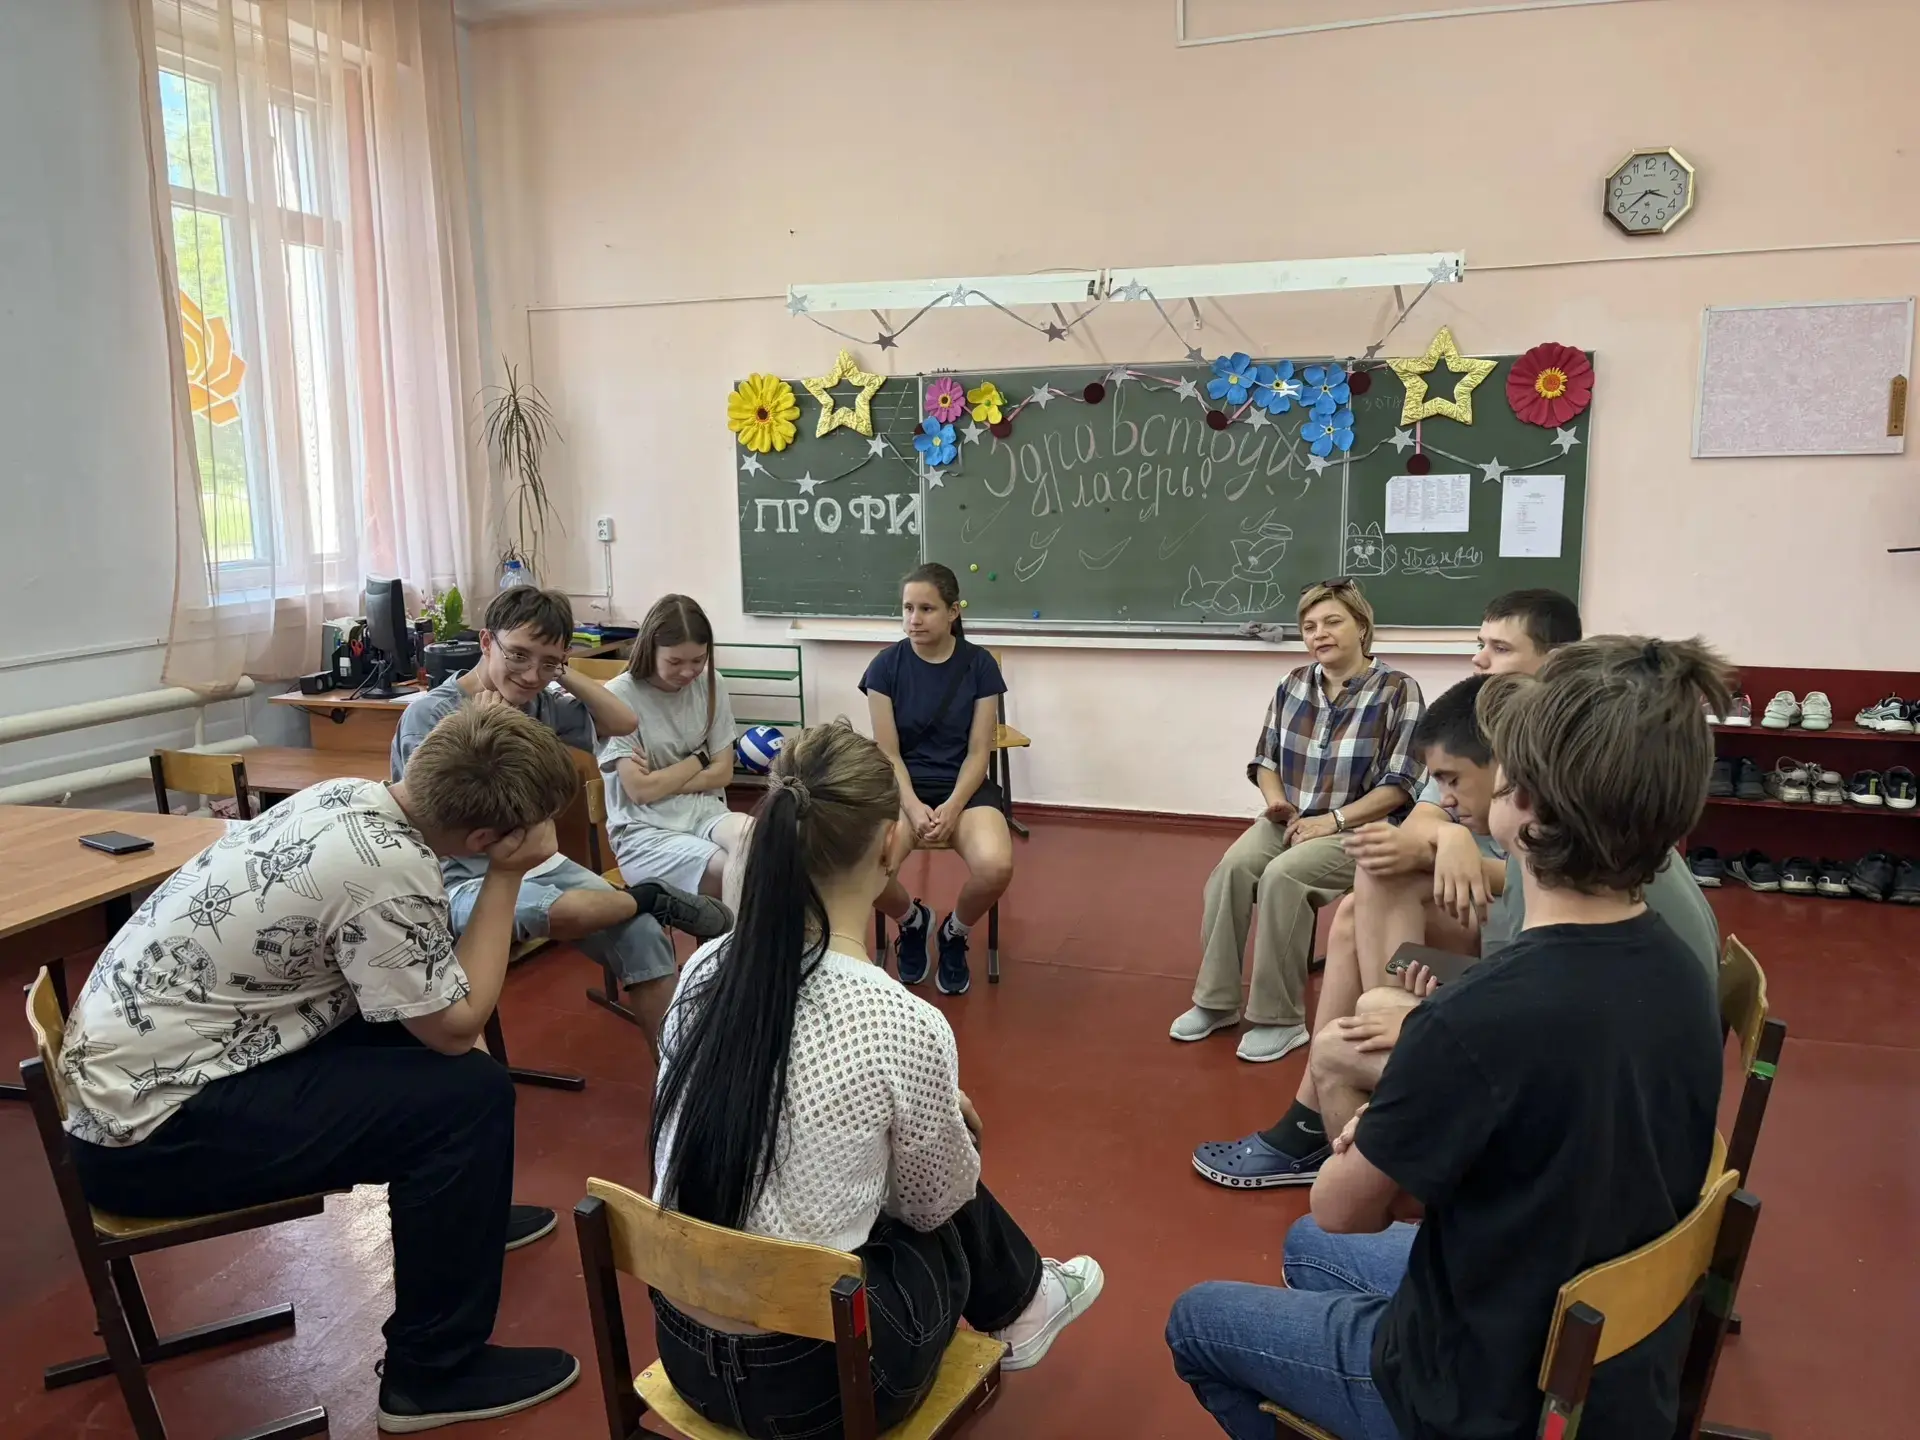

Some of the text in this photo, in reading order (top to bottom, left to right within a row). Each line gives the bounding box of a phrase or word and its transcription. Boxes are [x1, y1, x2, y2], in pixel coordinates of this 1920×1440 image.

[1632, 164, 1639, 174] 11
[1645, 157, 1657, 170] 12
[1662, 161, 1667, 172] 1
[1620, 175, 1632, 186] 10
[1669, 169, 1680, 181] 2
[1614, 188, 1623, 200] 9
[1674, 183, 1683, 196] 3
[1618, 202, 1626, 213] 8
[1667, 198, 1676, 209] 4
[1630, 211, 1638, 223] 7
[1641, 214, 1650, 225] 6
[1656, 208, 1665, 220] 5
[1070, 456, 1213, 518] лагерь!
[753, 493, 921, 535] ПРОФИ
[1210, 1171, 1263, 1186] crocs
